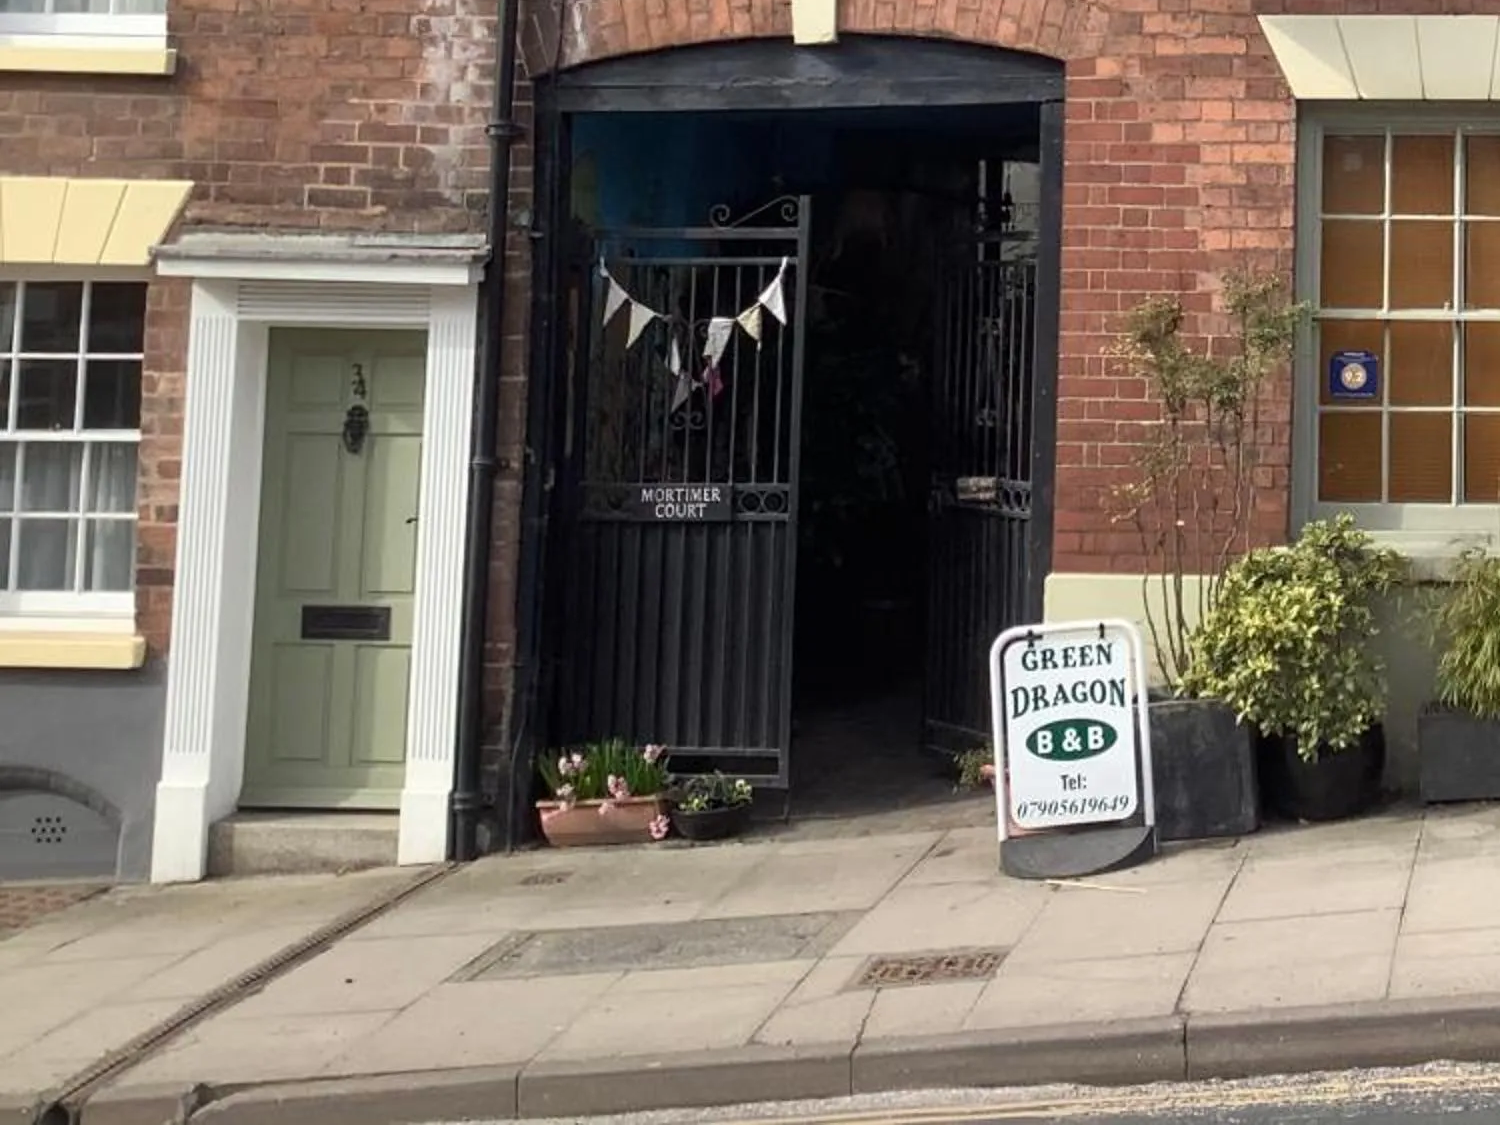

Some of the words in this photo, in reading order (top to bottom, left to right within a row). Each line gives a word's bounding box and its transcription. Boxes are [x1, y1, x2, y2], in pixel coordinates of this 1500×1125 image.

[640, 488, 721, 503] MORTIMER
[654, 503, 707, 518] COURT
[1021, 643, 1113, 672] GREEN
[1011, 677, 1126, 720] DRAGON
[1060, 773, 1087, 792] Tel:
